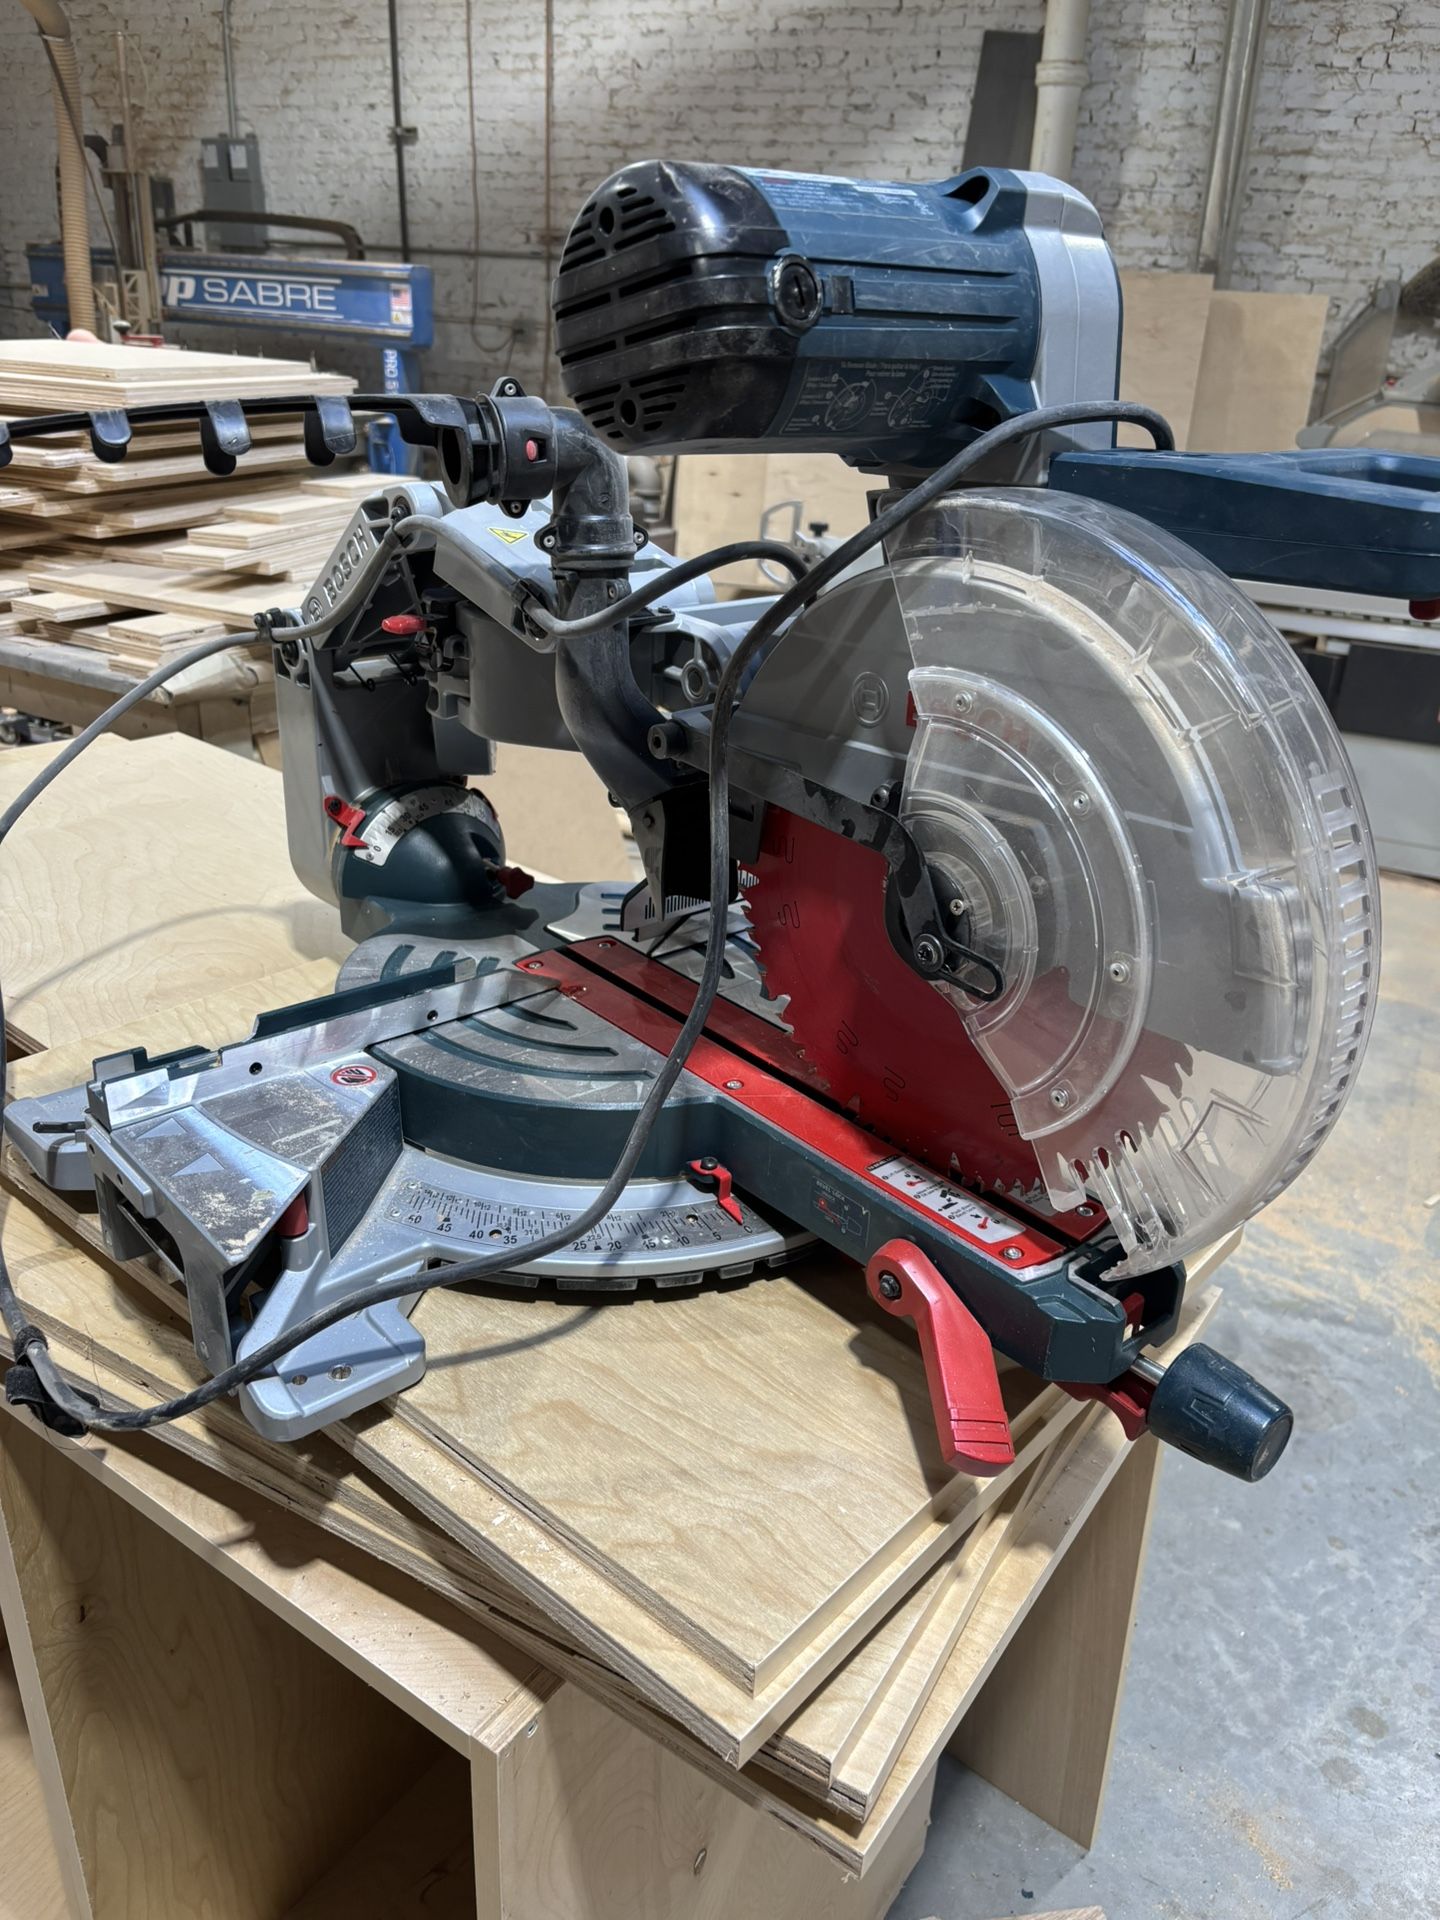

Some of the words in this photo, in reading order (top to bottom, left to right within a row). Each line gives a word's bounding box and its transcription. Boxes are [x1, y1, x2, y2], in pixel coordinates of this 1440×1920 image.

[203, 278, 337, 311] SABRE
[383, 349, 398, 378] PRO
[323, 524, 369, 608] BOSCH
[437, 1223, 452, 1233] 45
[469, 1230, 484, 1240] 40
[503, 1235, 518, 1245] 35
[573, 1240, 587, 1251] 25
[607, 1240, 622, 1251] 20
[643, 1239, 657, 1250] 15
[677, 1235, 690, 1246] 10
[712, 1231, 722, 1241] 5
[743, 1225, 753, 1234] 0
